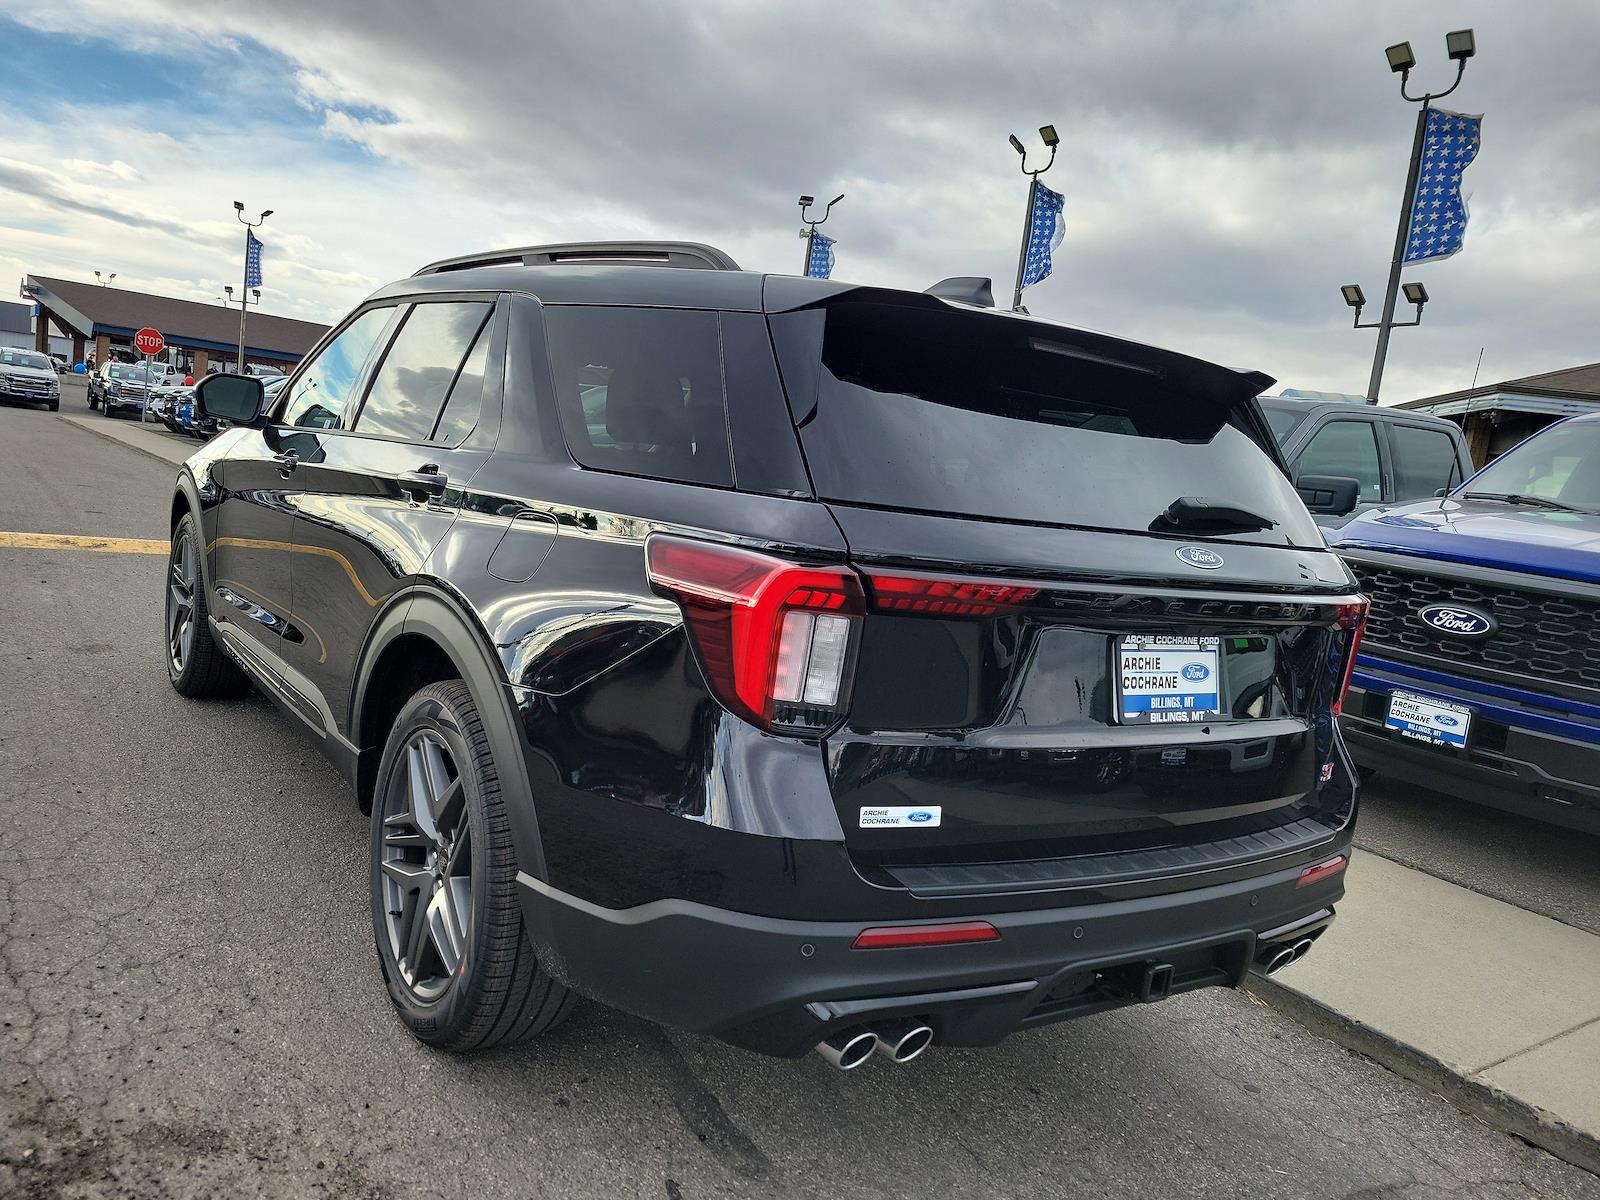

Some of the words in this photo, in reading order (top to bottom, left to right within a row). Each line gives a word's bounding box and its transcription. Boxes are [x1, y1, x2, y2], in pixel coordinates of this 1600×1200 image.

[136, 335, 163, 347] STOP
[1433, 610, 1477, 632] Ford
[1124, 635, 1155, 644] ARCHIE
[1156, 636, 1198, 645] COCHRANE
[1199, 636, 1220, 645] FORD
[1123, 657, 1161, 670] ARCHIE
[1186, 664, 1205, 679] Ford
[1123, 676, 1178, 690] COCHRANE
[1151, 696, 1183, 709] BILLINGS,
[1184, 696, 1195, 708] MT
[1392, 700, 1421, 712] ARCHIE
[1150, 712, 1190, 723] BILLINGS,
[1191, 711, 1206, 721] MT
[1391, 708, 1431, 725] COCHRANE
[1407, 723, 1433, 736] BILLINGS,
[1401, 730, 1432, 744] BILLINGS,
[1433, 738, 1446, 747] MT
